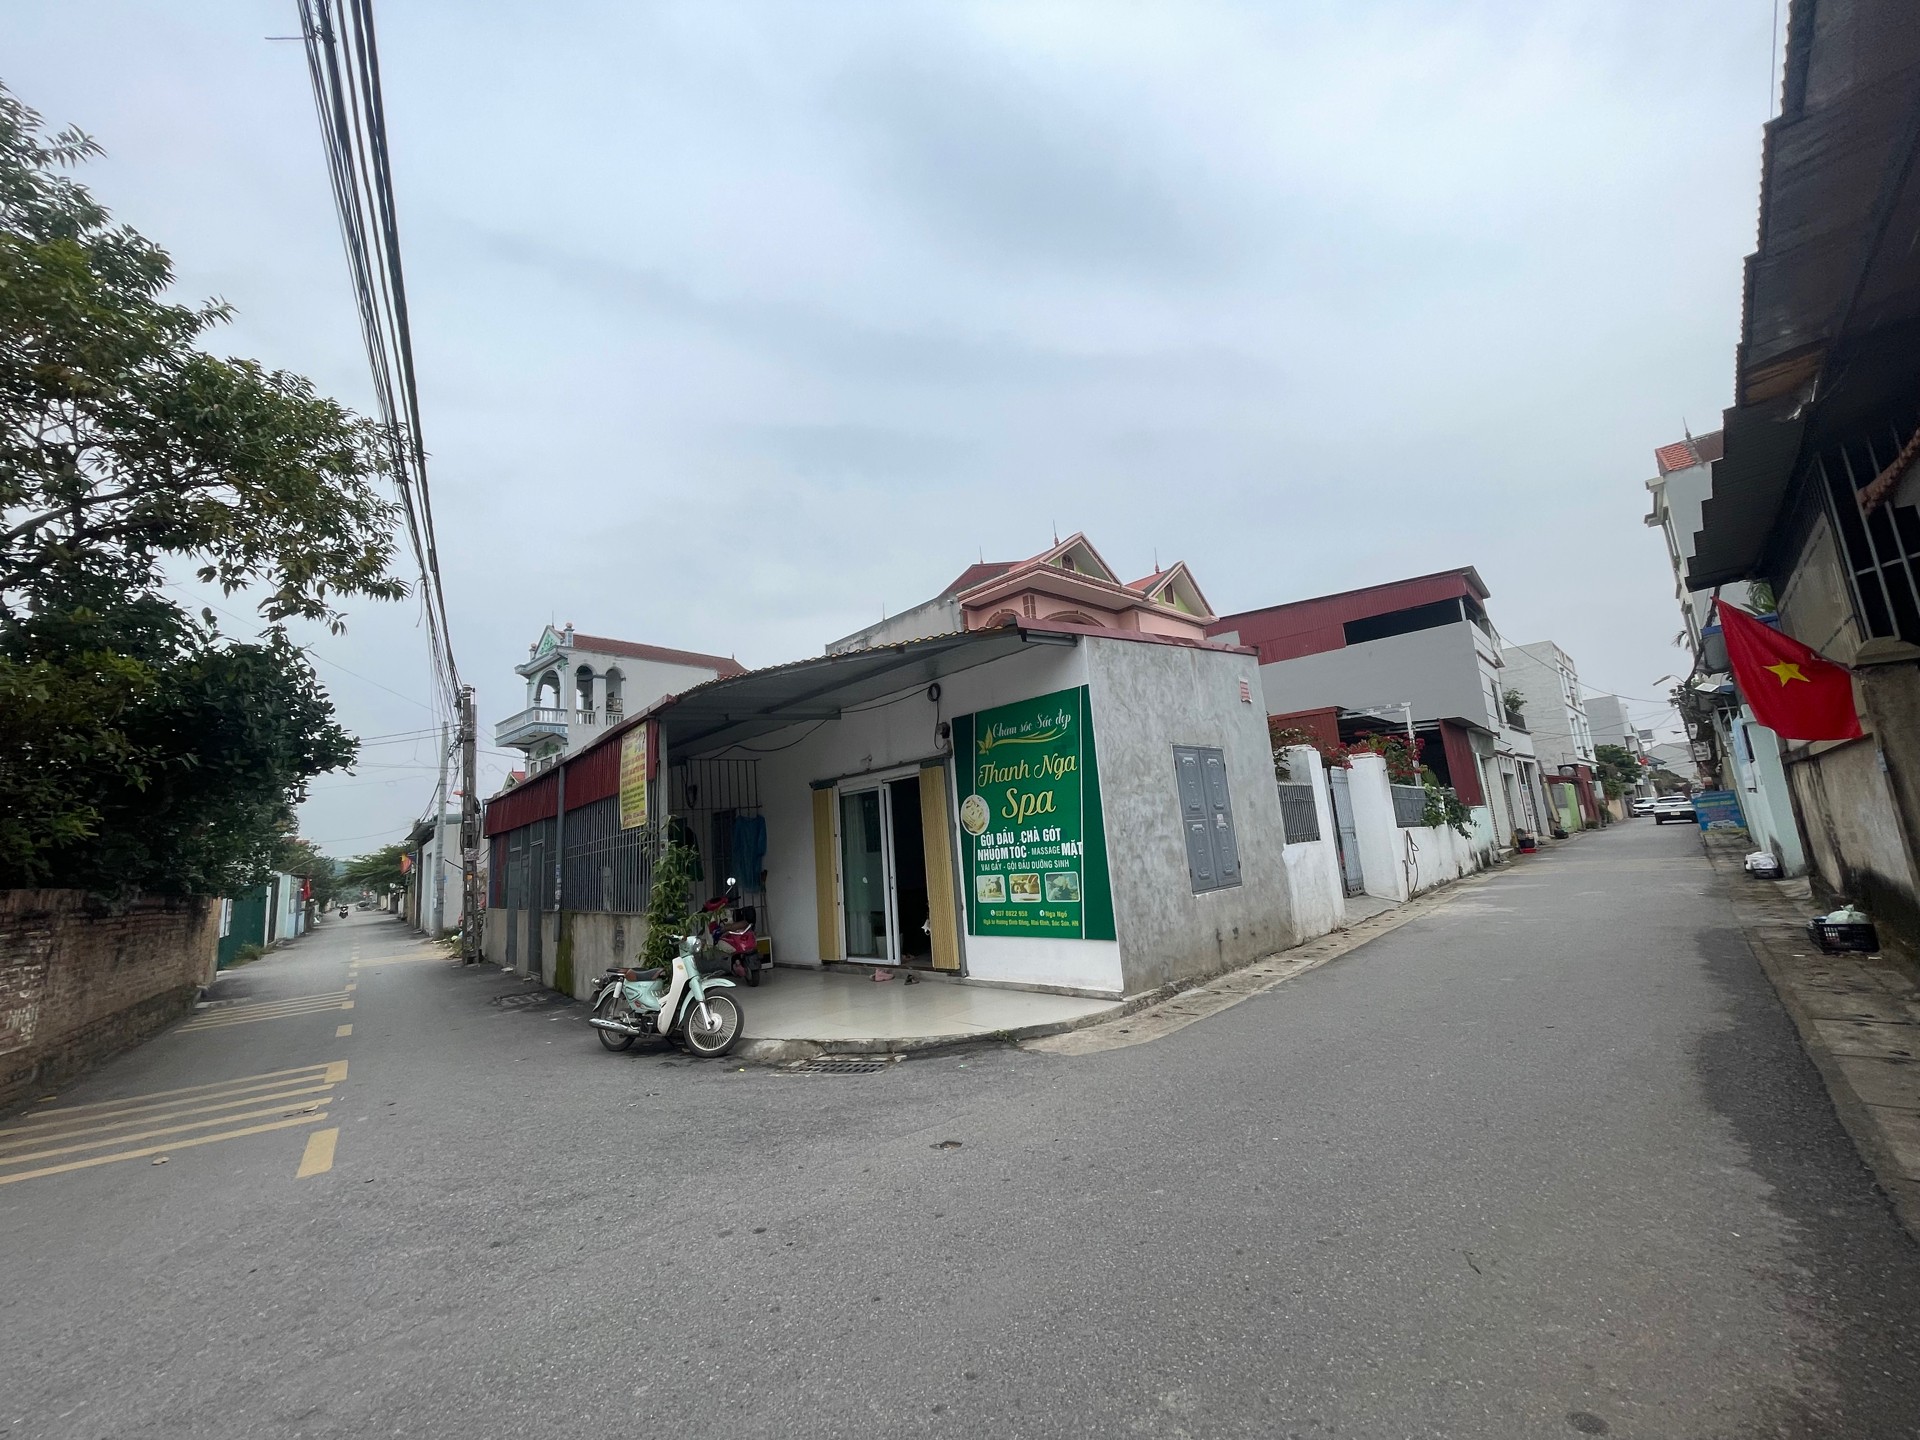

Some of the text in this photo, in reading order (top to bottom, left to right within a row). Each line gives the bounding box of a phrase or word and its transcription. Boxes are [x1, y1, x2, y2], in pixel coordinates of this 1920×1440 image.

[977, 753, 1077, 787] Thanh Nga
[1001, 787, 1057, 825] Spa
[980, 825, 1061, 849] GỘI ĐẦU CHÀ GÓT
[977, 839, 1083, 862] NHUỘM TÓC MASSAGE MẶT
[1054, 859, 1070, 868] SINH
